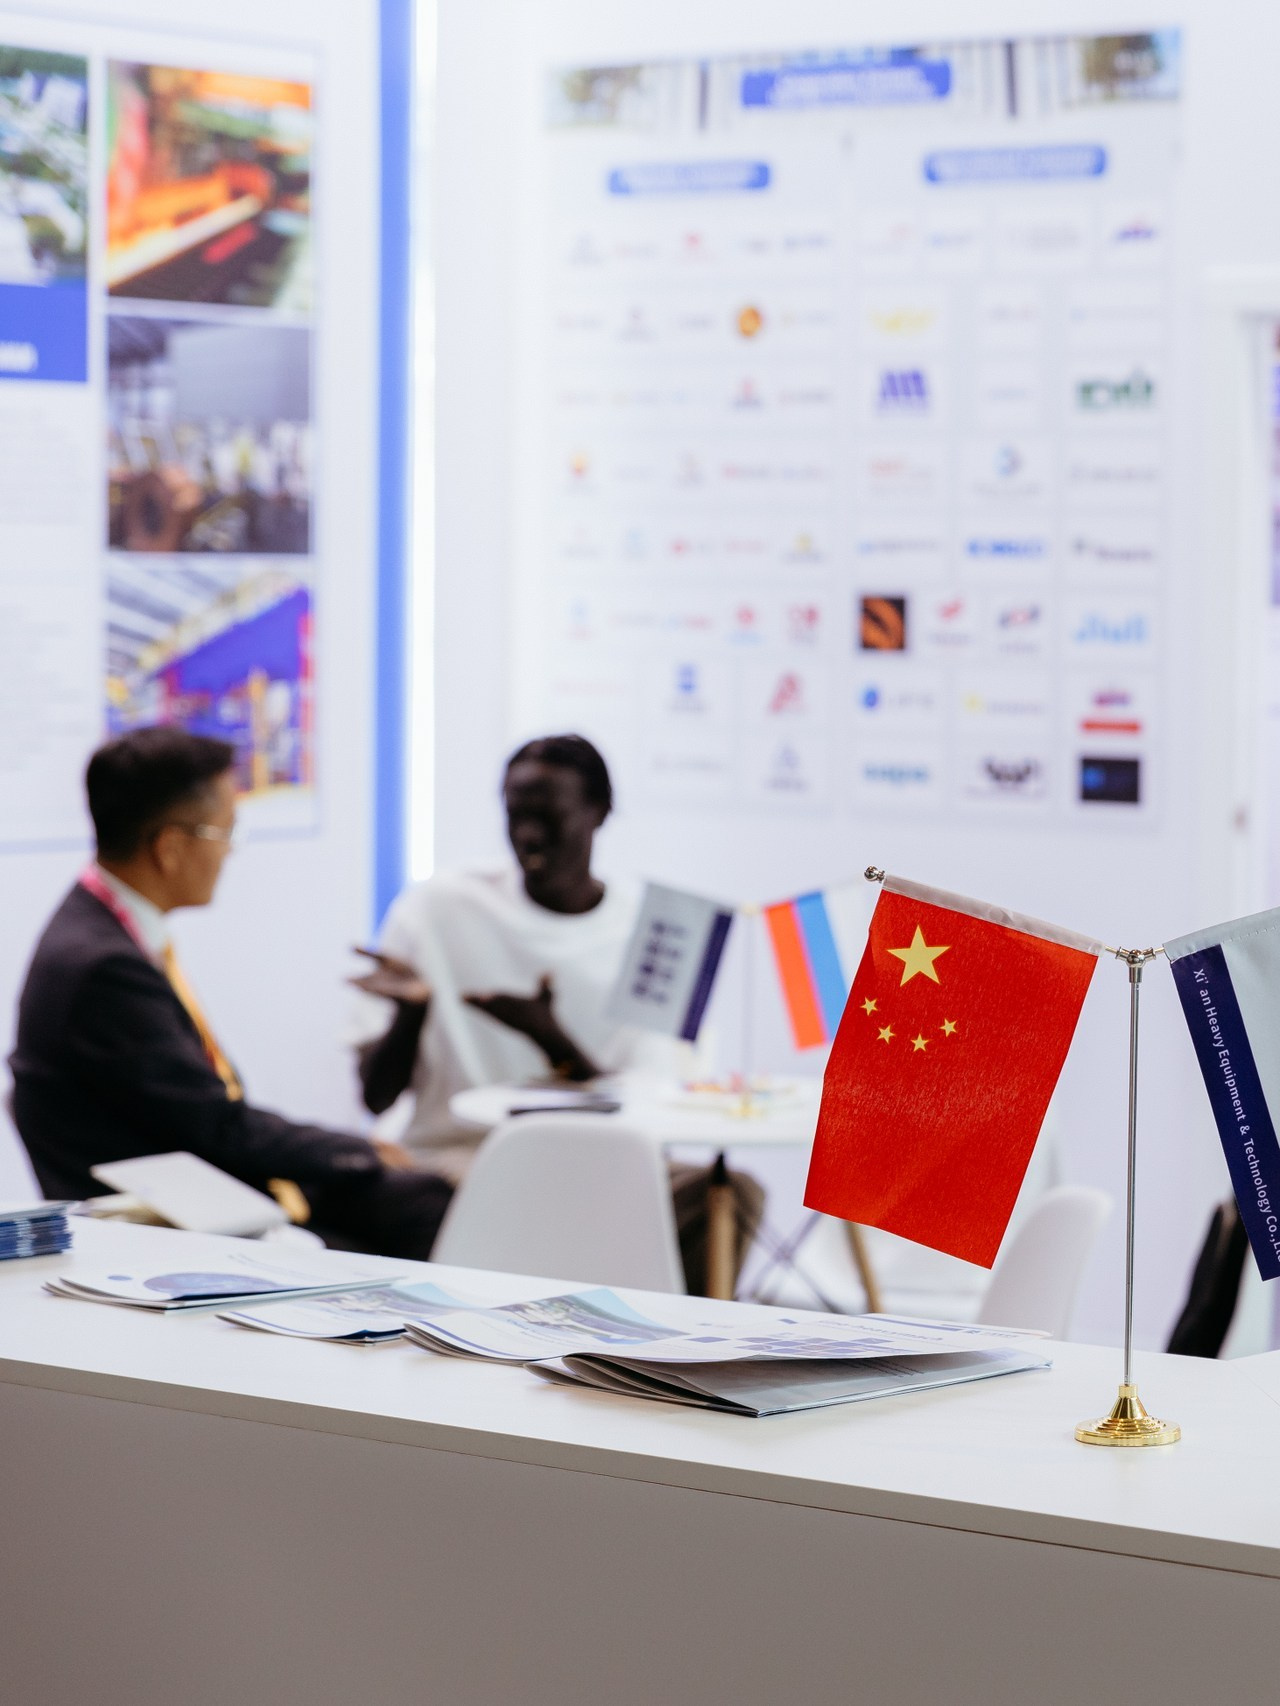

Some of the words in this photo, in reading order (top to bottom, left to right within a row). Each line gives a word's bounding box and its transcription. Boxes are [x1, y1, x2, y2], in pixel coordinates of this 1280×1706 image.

[1205, 1006, 1224, 1048] Heavy
[1218, 1049, 1247, 1122] Equipment
[1239, 1125, 1250, 1136] &
[1243, 1138, 1272, 1213] Technology
